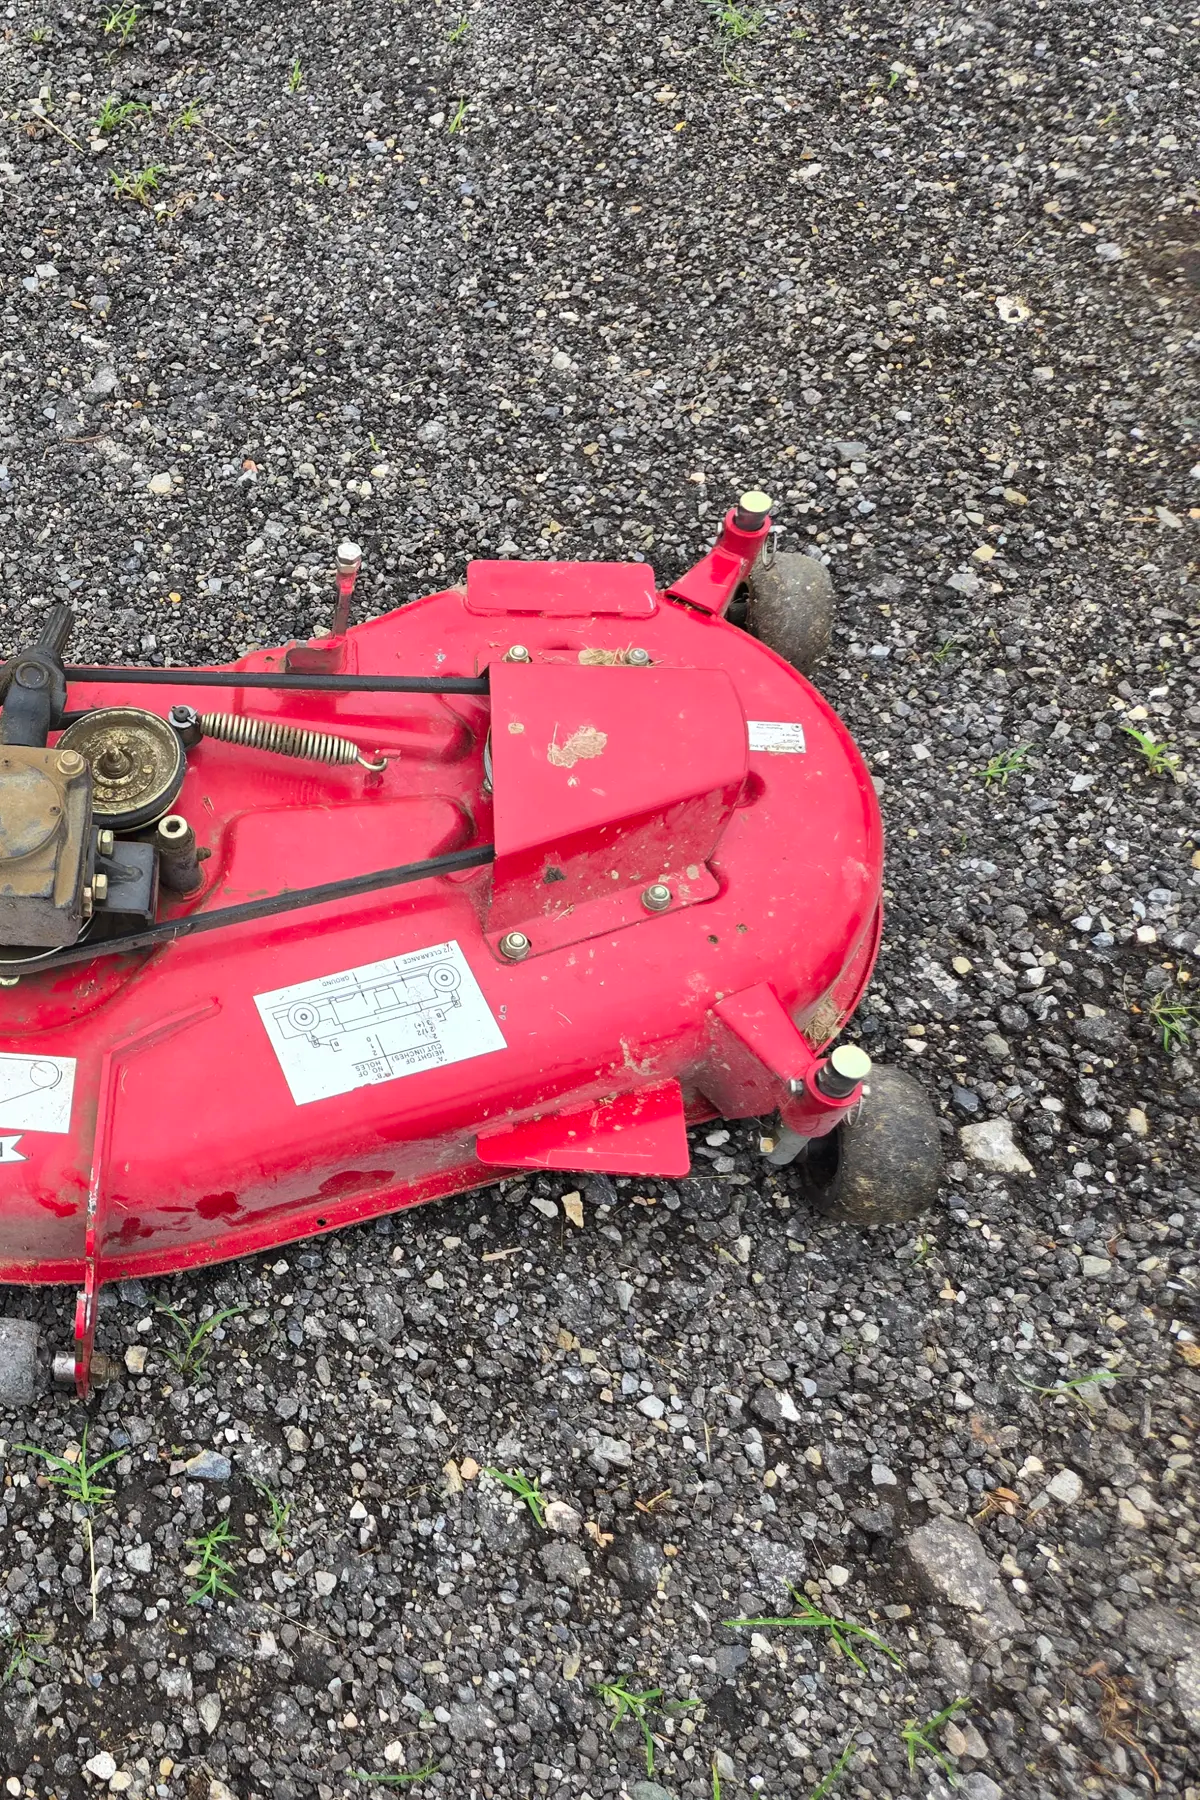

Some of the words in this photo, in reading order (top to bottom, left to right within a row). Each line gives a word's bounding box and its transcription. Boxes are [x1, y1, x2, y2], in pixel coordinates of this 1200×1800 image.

[402, 949, 442, 964] CLEARANCE
[322, 975, 350, 986] GROUND
[416, 1028, 428, 1036] 1/2
[428, 1043, 442, 1052] CUT
[392, 1048, 425, 1062] (INCHES)
[418, 1049, 444, 1061] HEIGHT
[355, 1060, 381, 1071] HOLES
